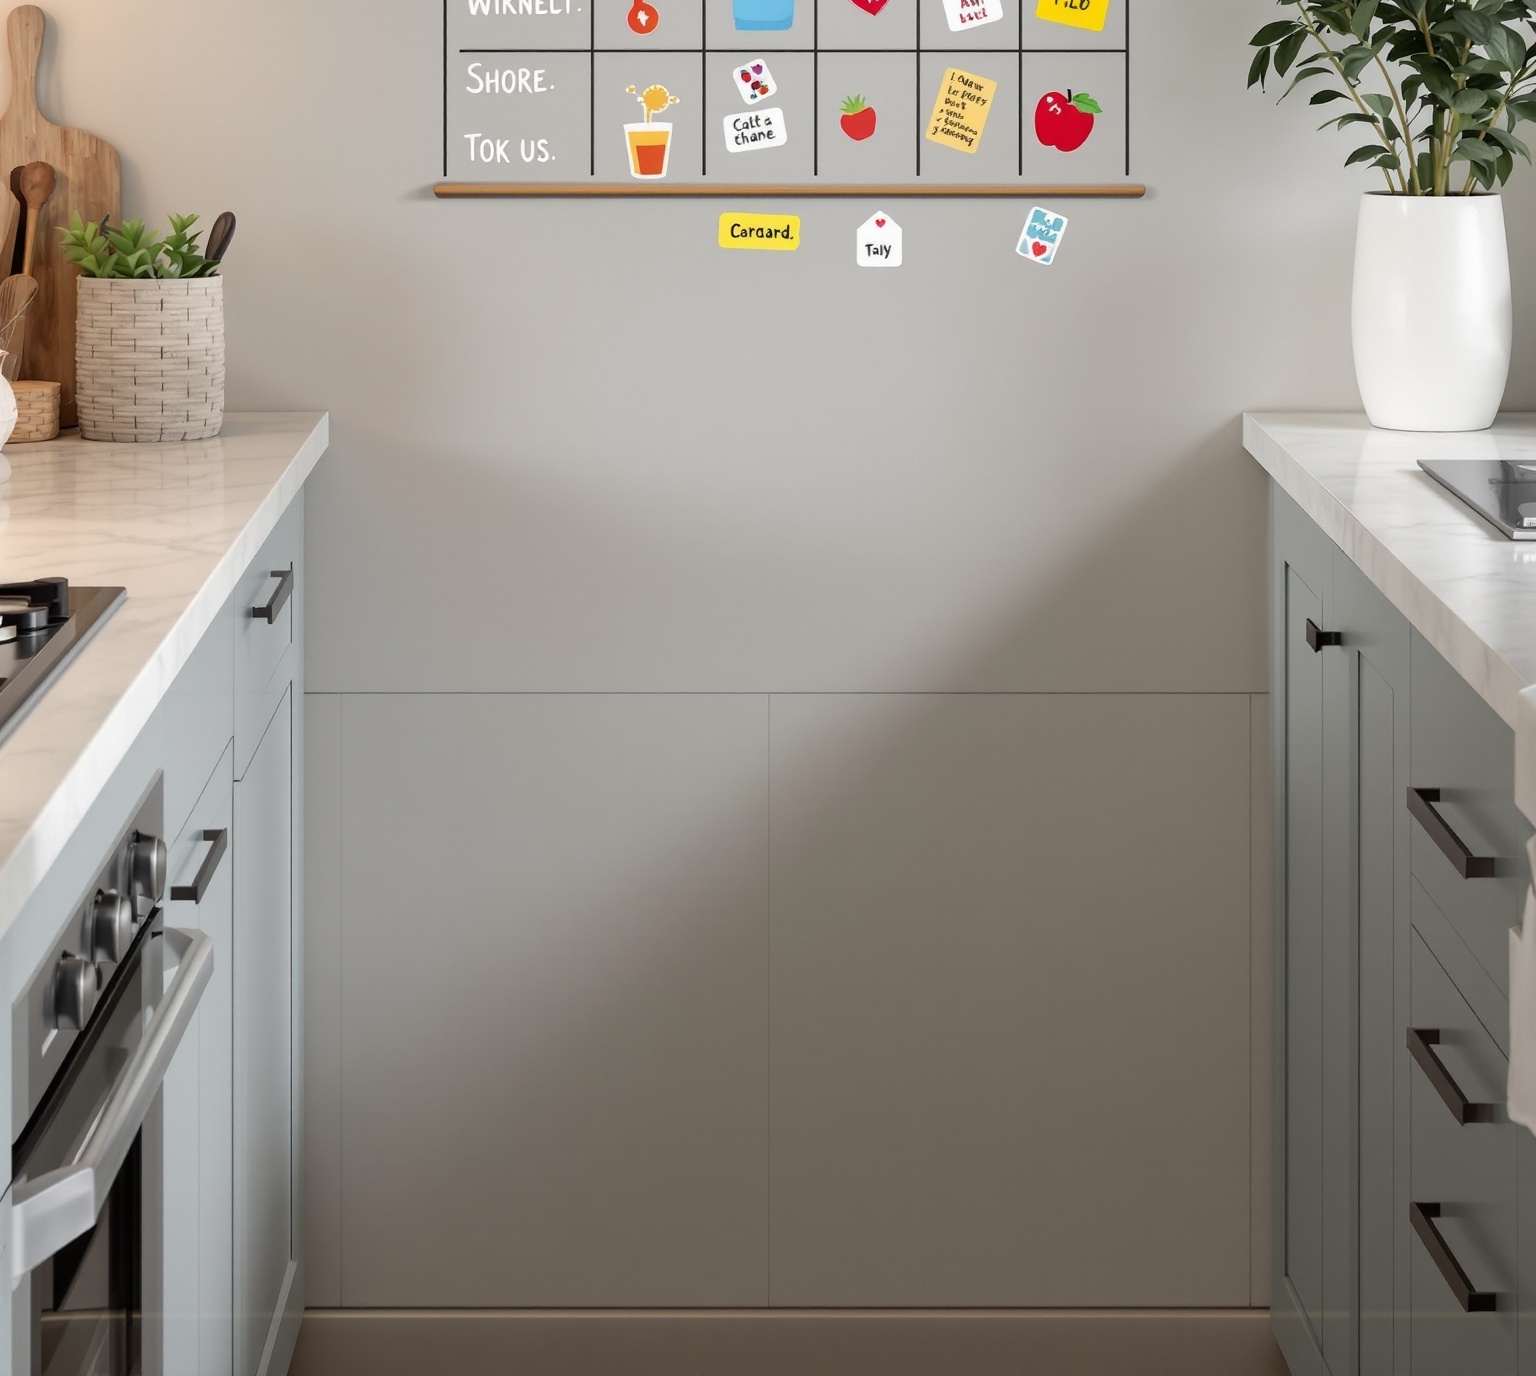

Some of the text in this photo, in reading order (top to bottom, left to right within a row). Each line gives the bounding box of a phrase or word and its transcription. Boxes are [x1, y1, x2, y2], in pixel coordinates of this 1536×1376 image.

[464, 61, 556, 95] SHORE.
[463, 132, 557, 164] TOK US.
